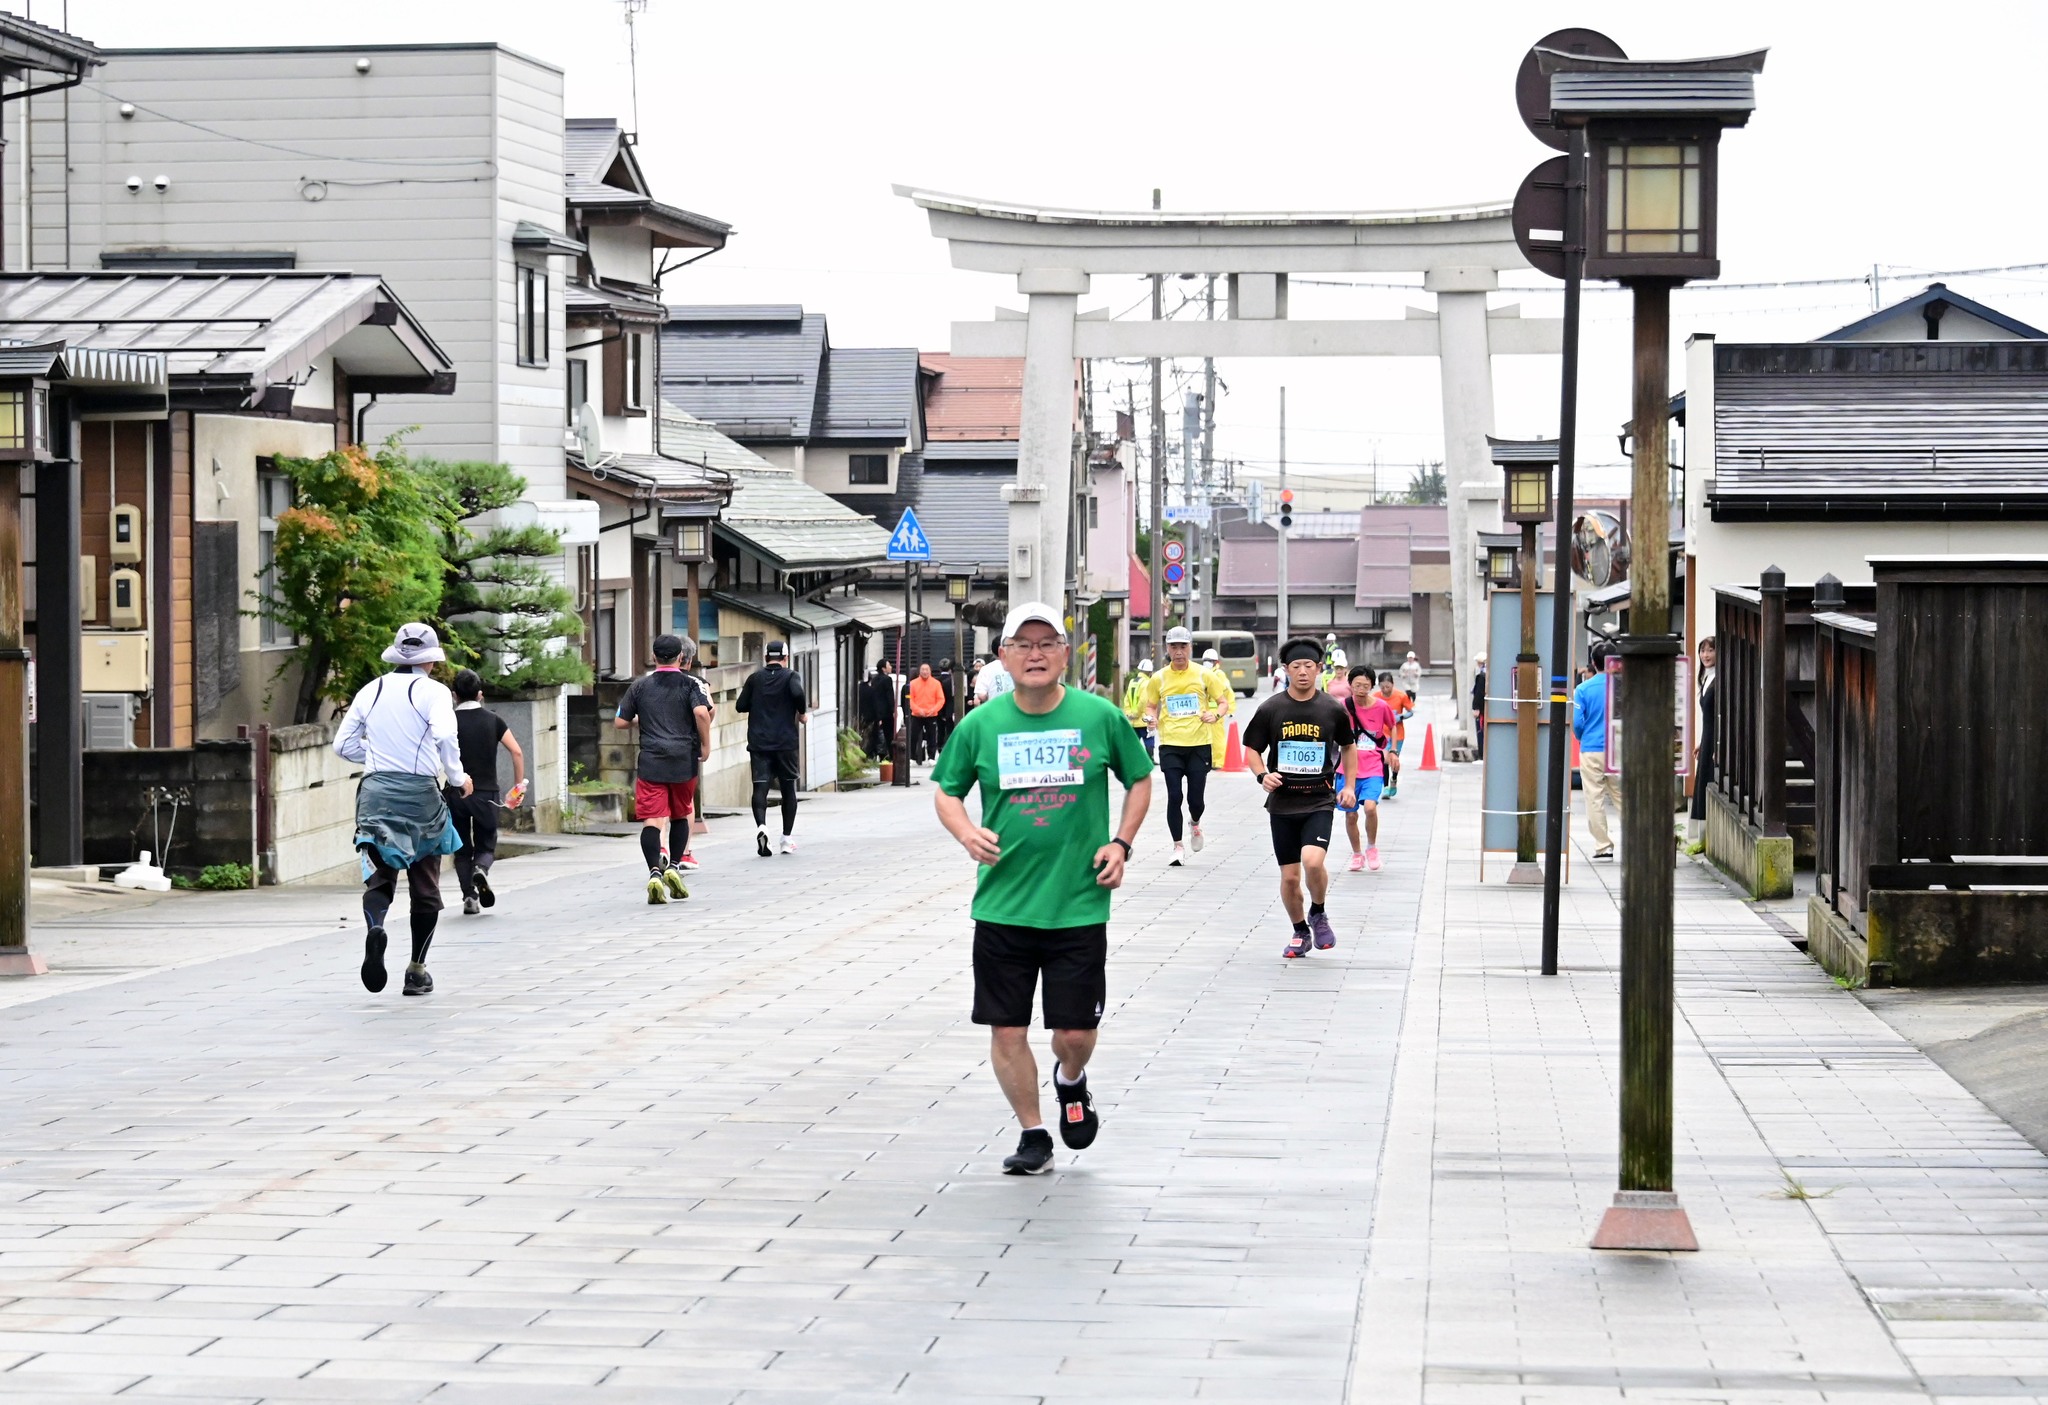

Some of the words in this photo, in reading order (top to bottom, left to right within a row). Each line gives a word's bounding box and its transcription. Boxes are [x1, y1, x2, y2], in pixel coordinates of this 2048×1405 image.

[1168, 547, 1179, 557] 30
[1176, 700, 1192, 708] 1441
[1282, 723, 1320, 739] PADRES
[1014, 752, 1021, 766] E
[1024, 745, 1066, 765] 1437
[1293, 750, 1316, 761] 1063
[1040, 773, 1075, 784] Asahi
[1010, 794, 1077, 804] MARATHON
